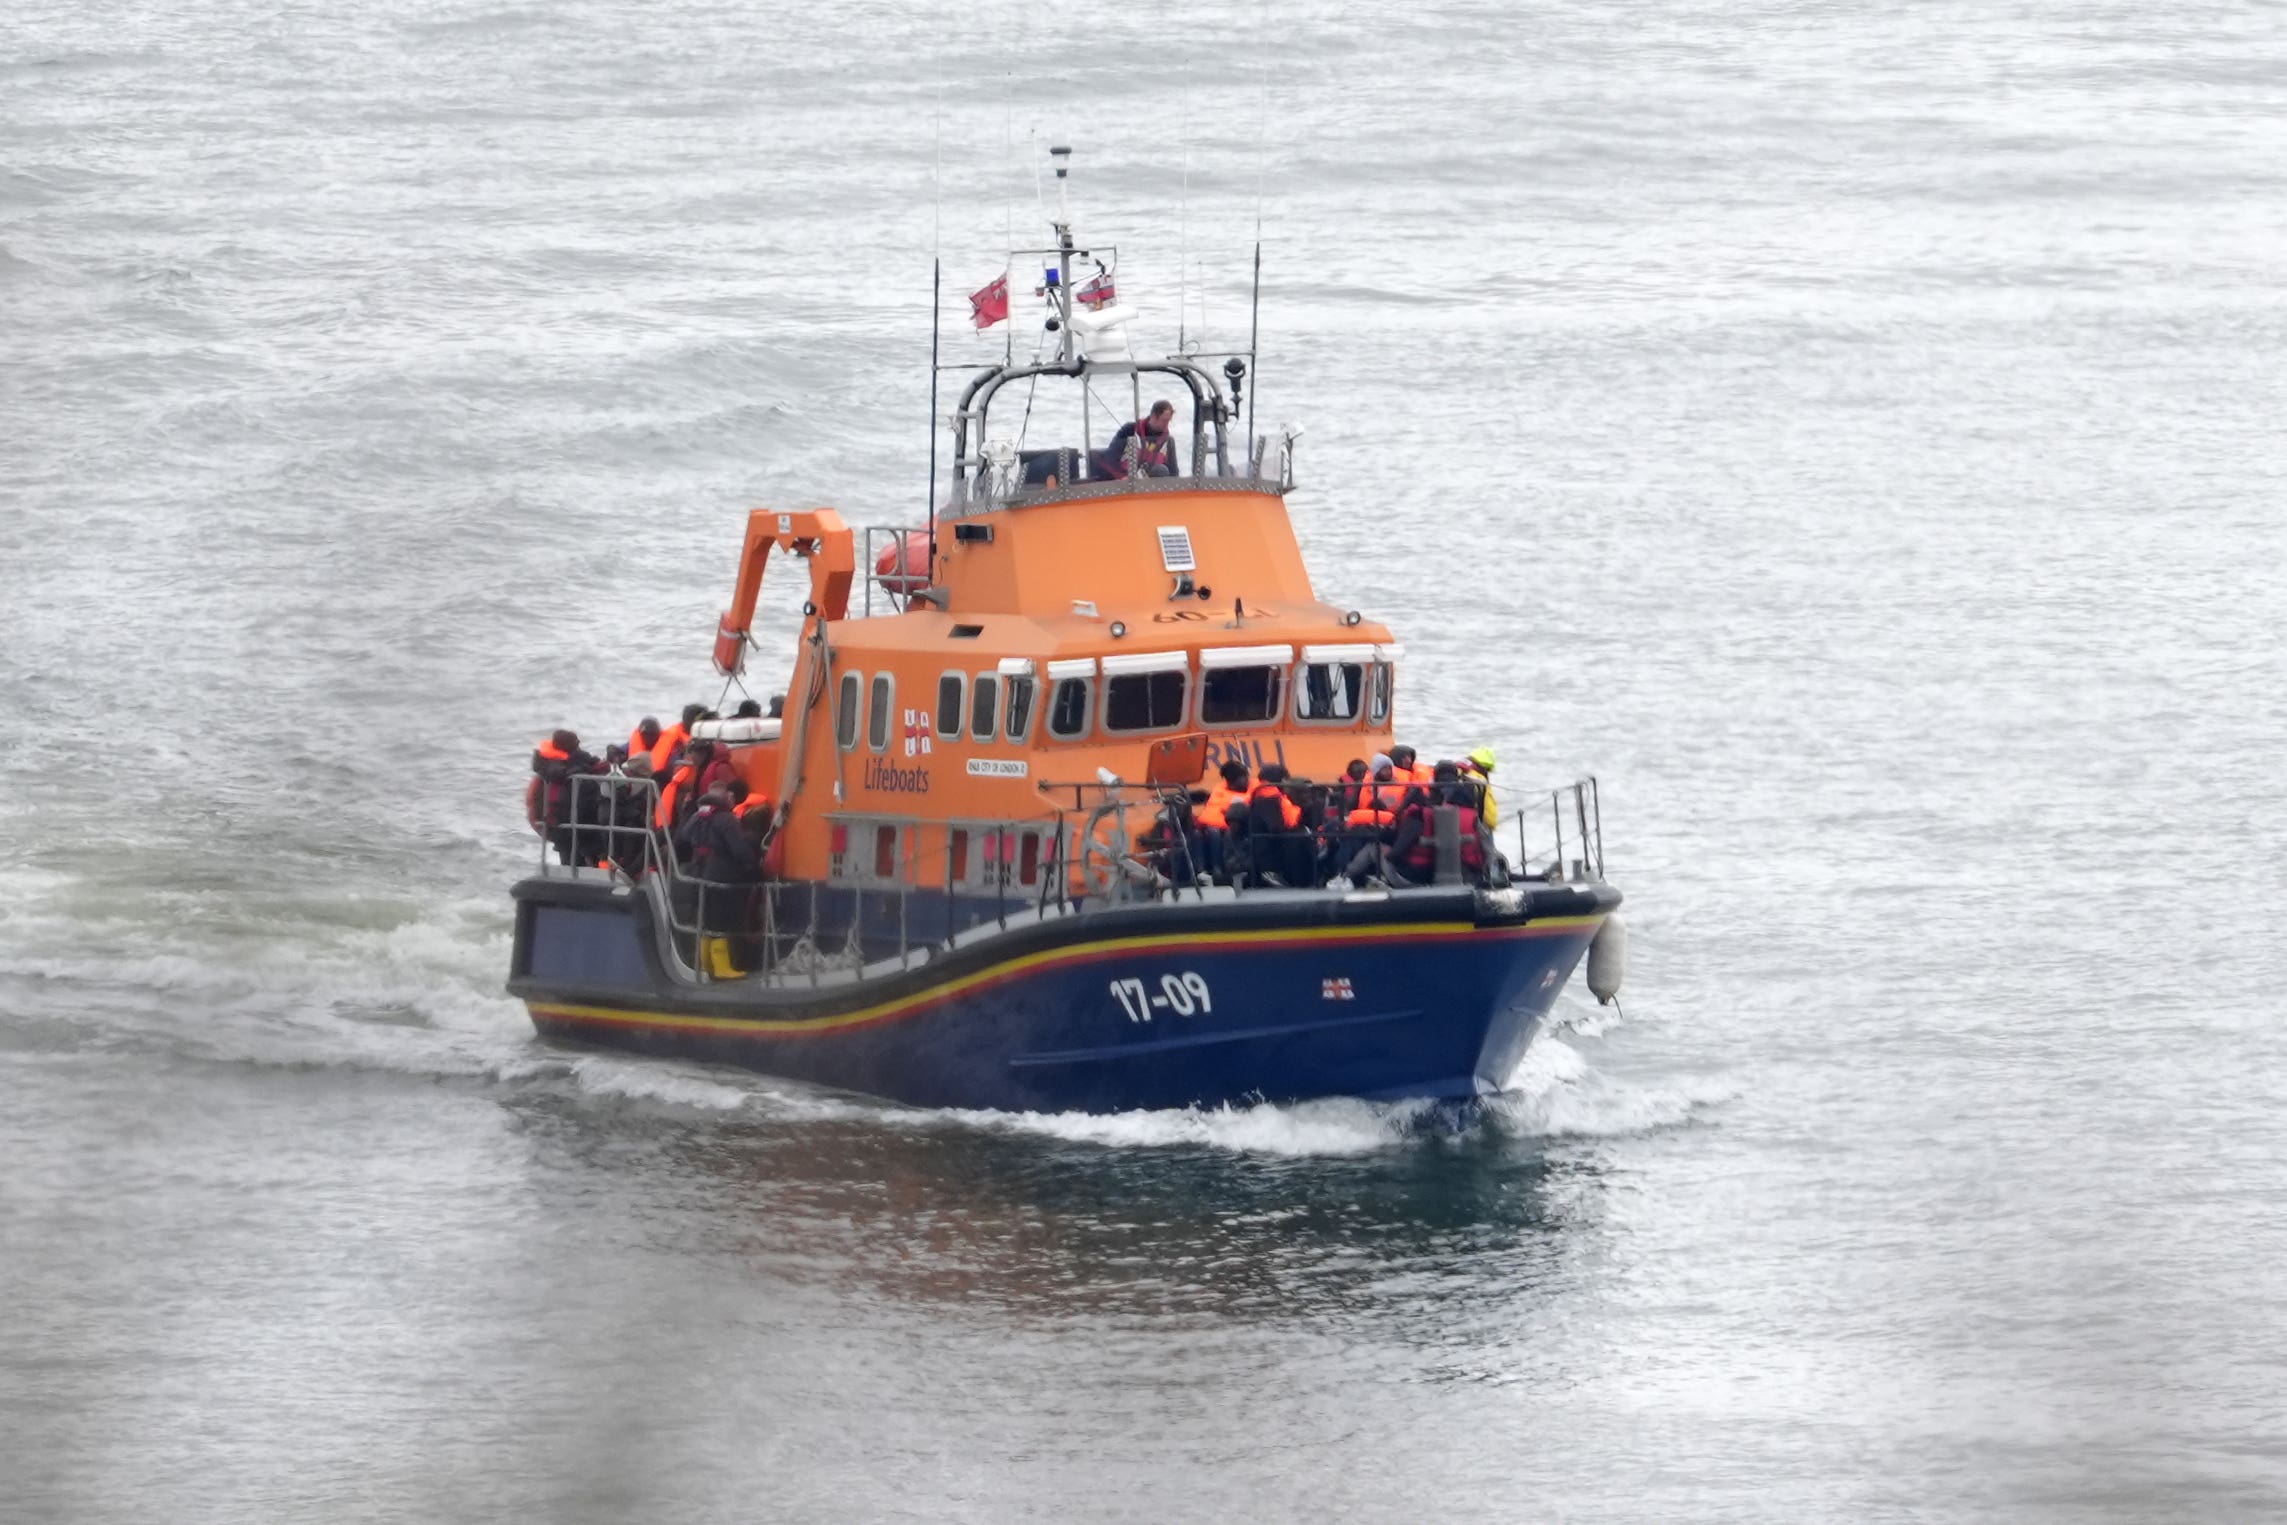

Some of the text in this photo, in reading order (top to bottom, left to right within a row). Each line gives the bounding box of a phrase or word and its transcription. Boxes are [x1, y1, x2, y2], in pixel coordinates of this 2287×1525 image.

[1205, 739, 1285, 770] RNLI
[865, 757, 929, 793] Lifeboats
[1110, 971, 1211, 1023] 17-09
